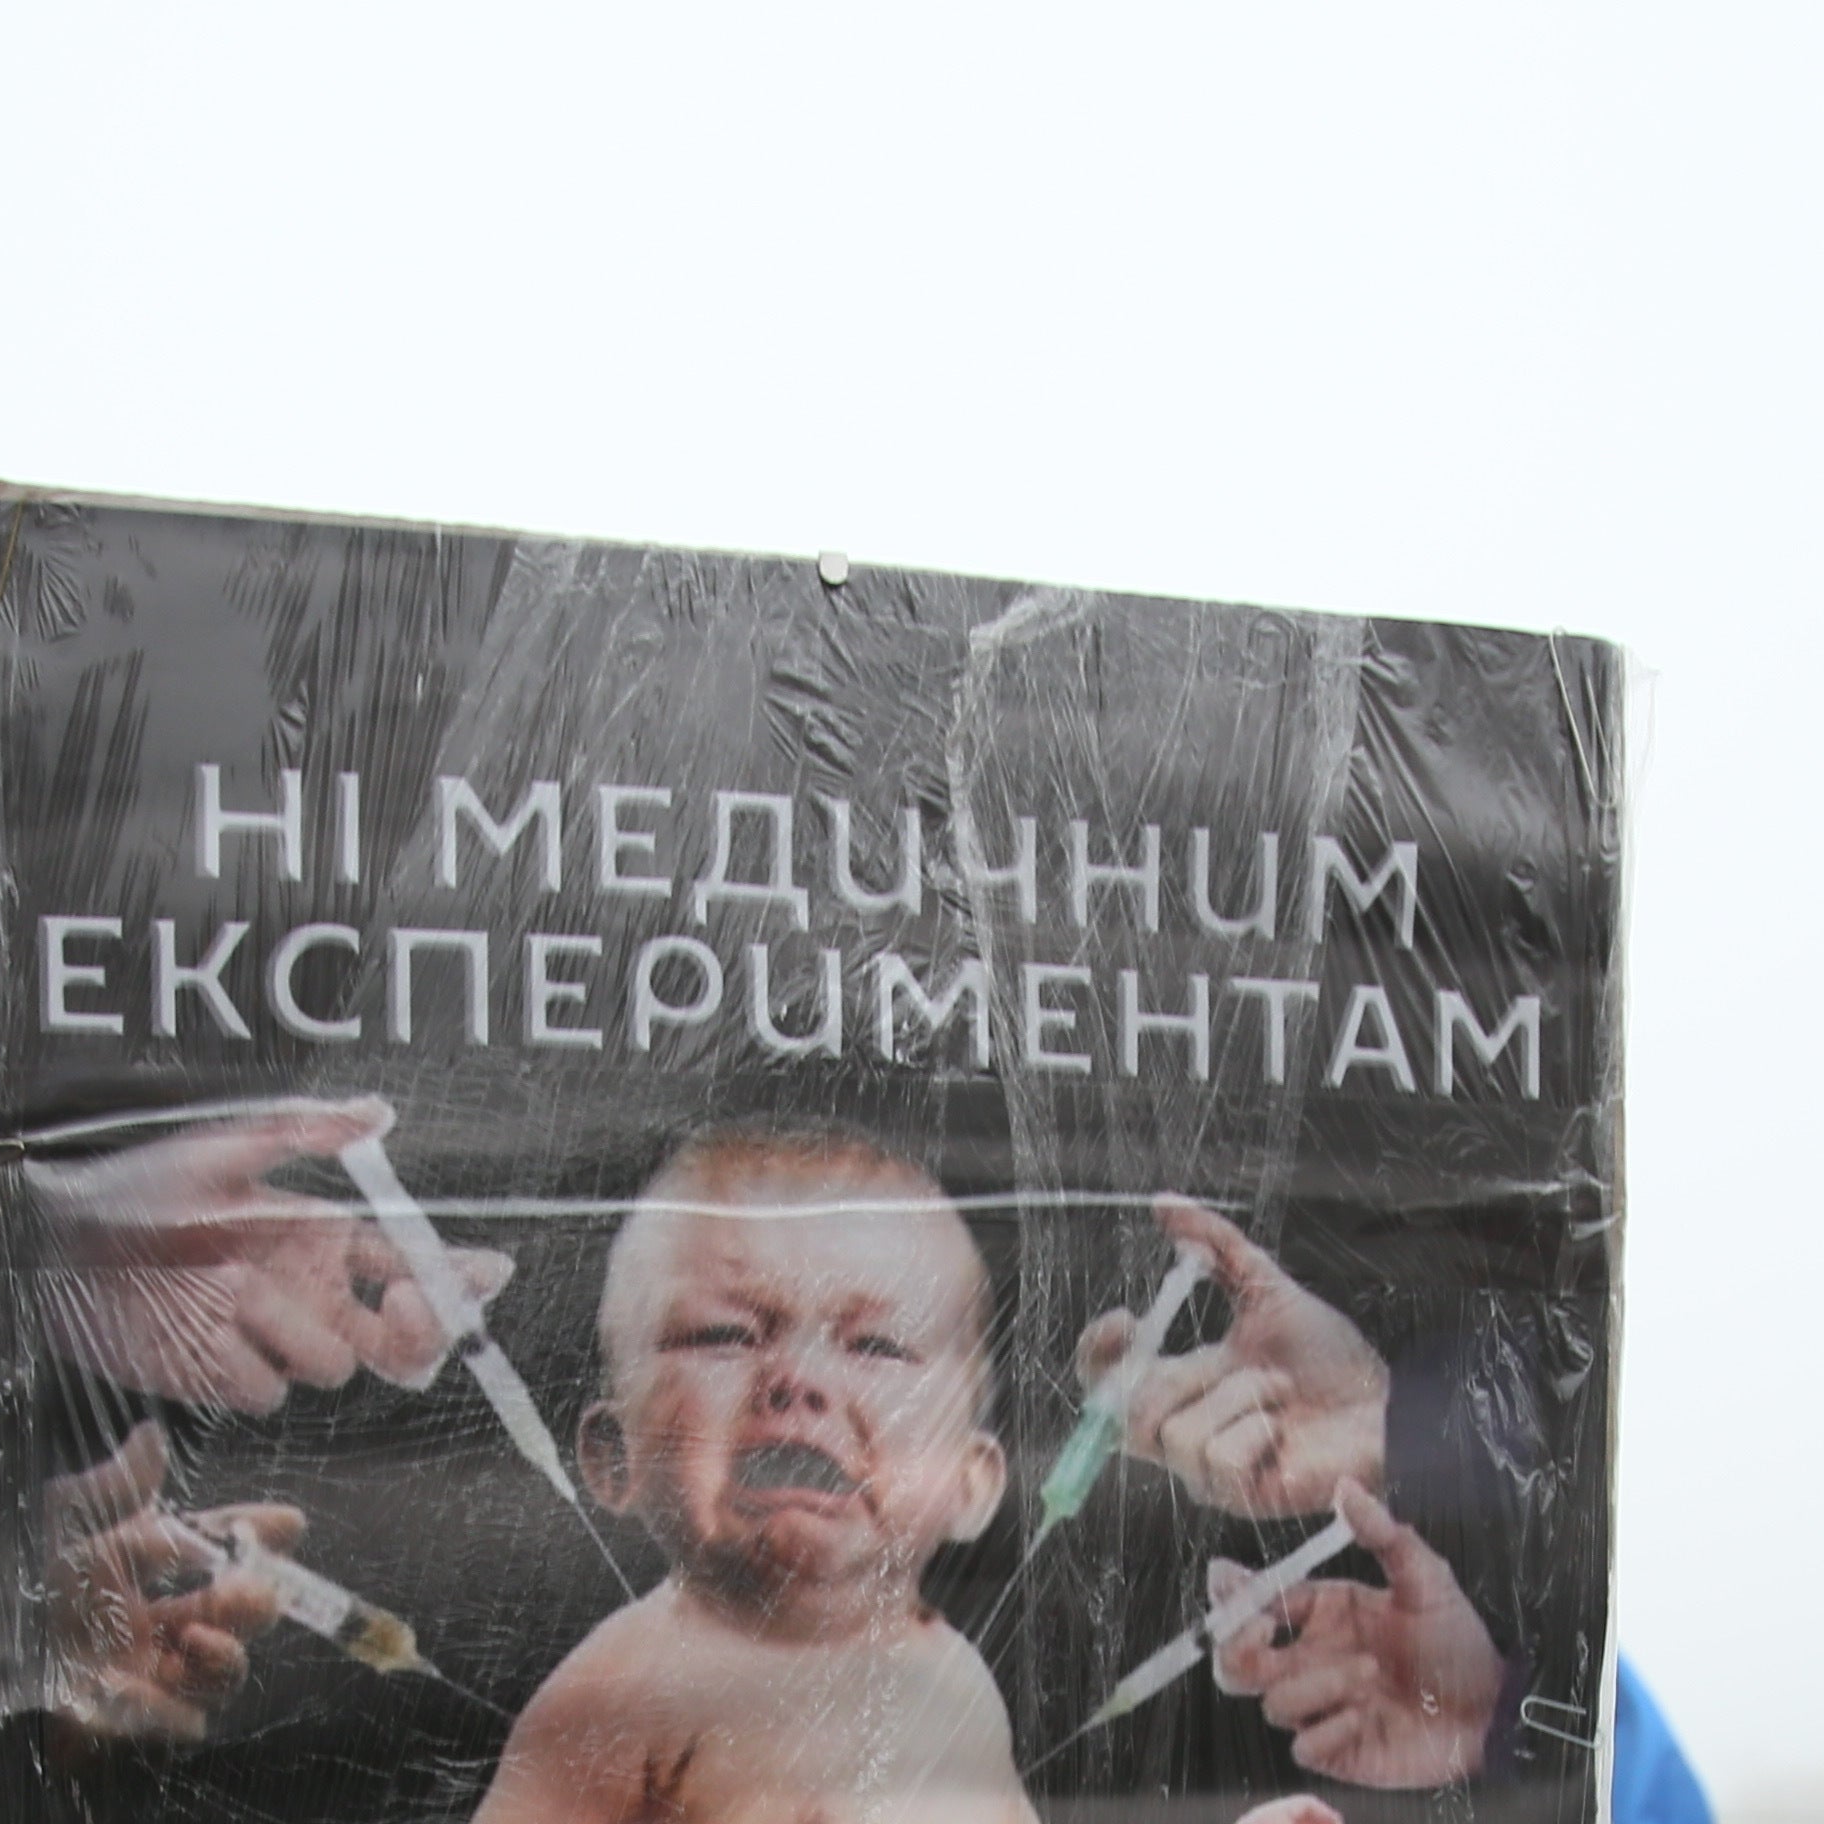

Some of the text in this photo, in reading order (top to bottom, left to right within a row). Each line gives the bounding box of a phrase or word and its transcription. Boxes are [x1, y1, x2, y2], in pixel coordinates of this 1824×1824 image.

[193, 762, 1420, 951] НІ МЕДИЧНИМ
[37, 914, 1545, 1099] ЕКСПЕРИМЕНТАМ
